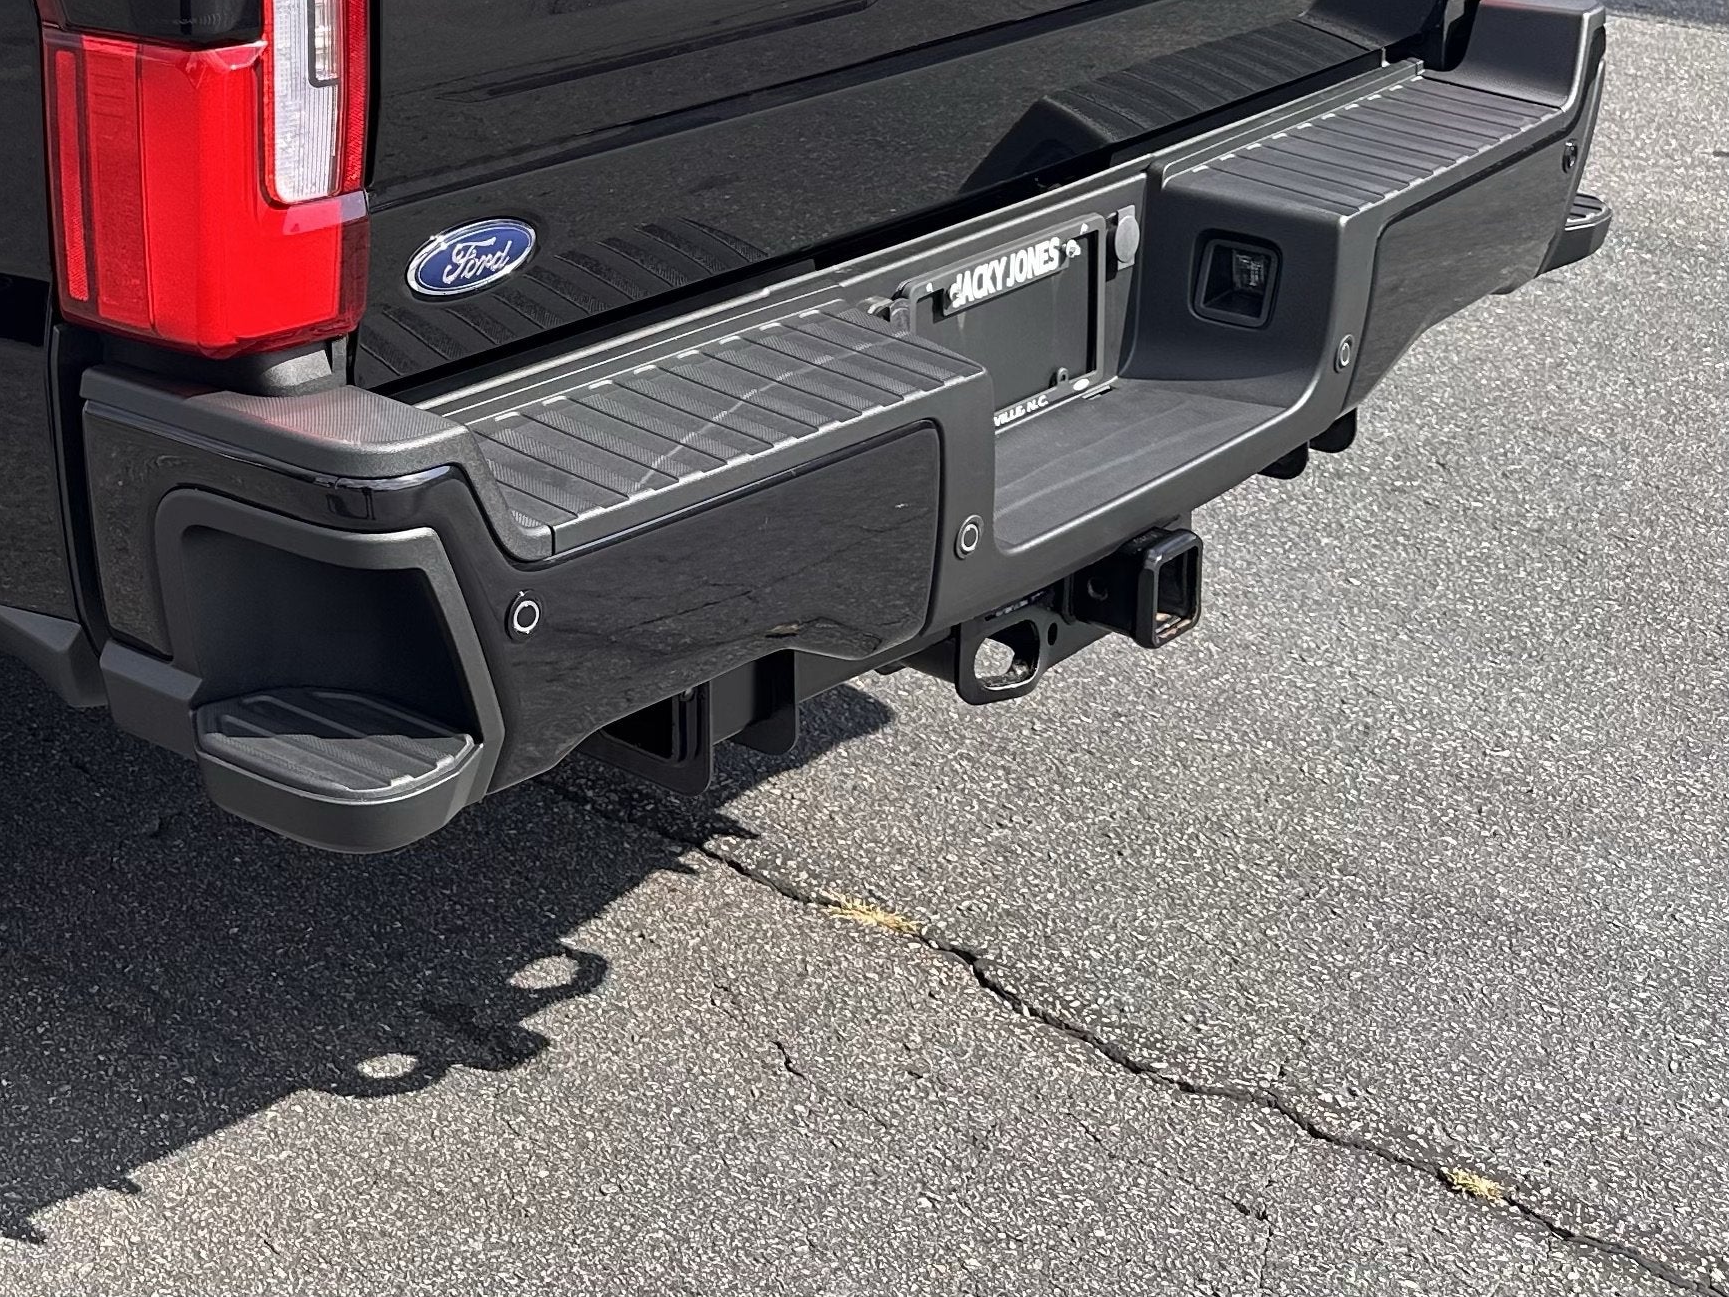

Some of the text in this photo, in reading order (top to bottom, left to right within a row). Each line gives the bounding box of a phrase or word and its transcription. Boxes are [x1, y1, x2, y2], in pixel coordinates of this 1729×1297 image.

[442, 236, 513, 284] Ford
[951, 236, 1060, 308] JACKY JONES
